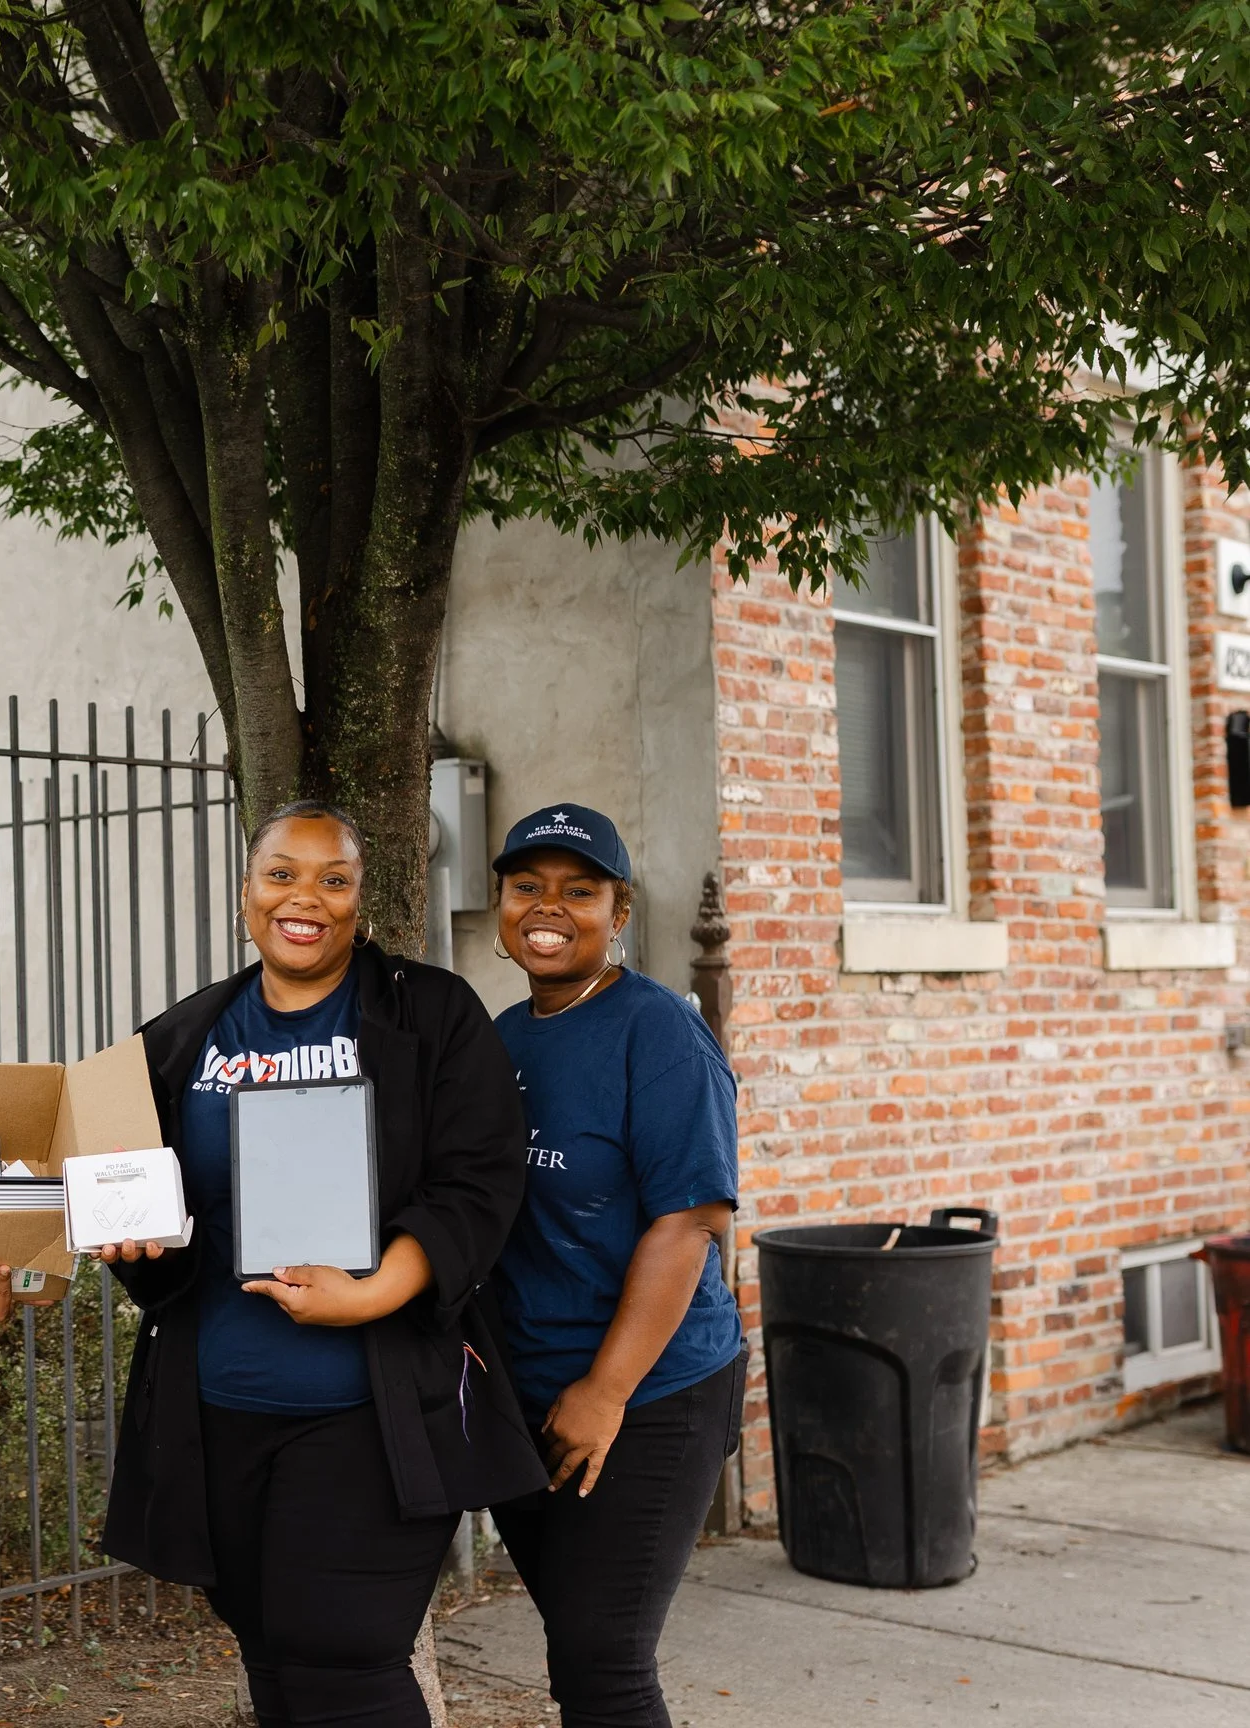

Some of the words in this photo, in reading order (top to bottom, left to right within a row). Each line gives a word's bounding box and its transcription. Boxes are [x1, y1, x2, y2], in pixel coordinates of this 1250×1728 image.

[554, 824, 584, 833] JERSEY
[526, 828, 565, 840] AMERICAN
[566, 829, 592, 841] WATER
[192, 1081, 214, 1092] BIG
[525, 1147, 568, 1170] TER
[113, 1167, 145, 1176] CHARGER
